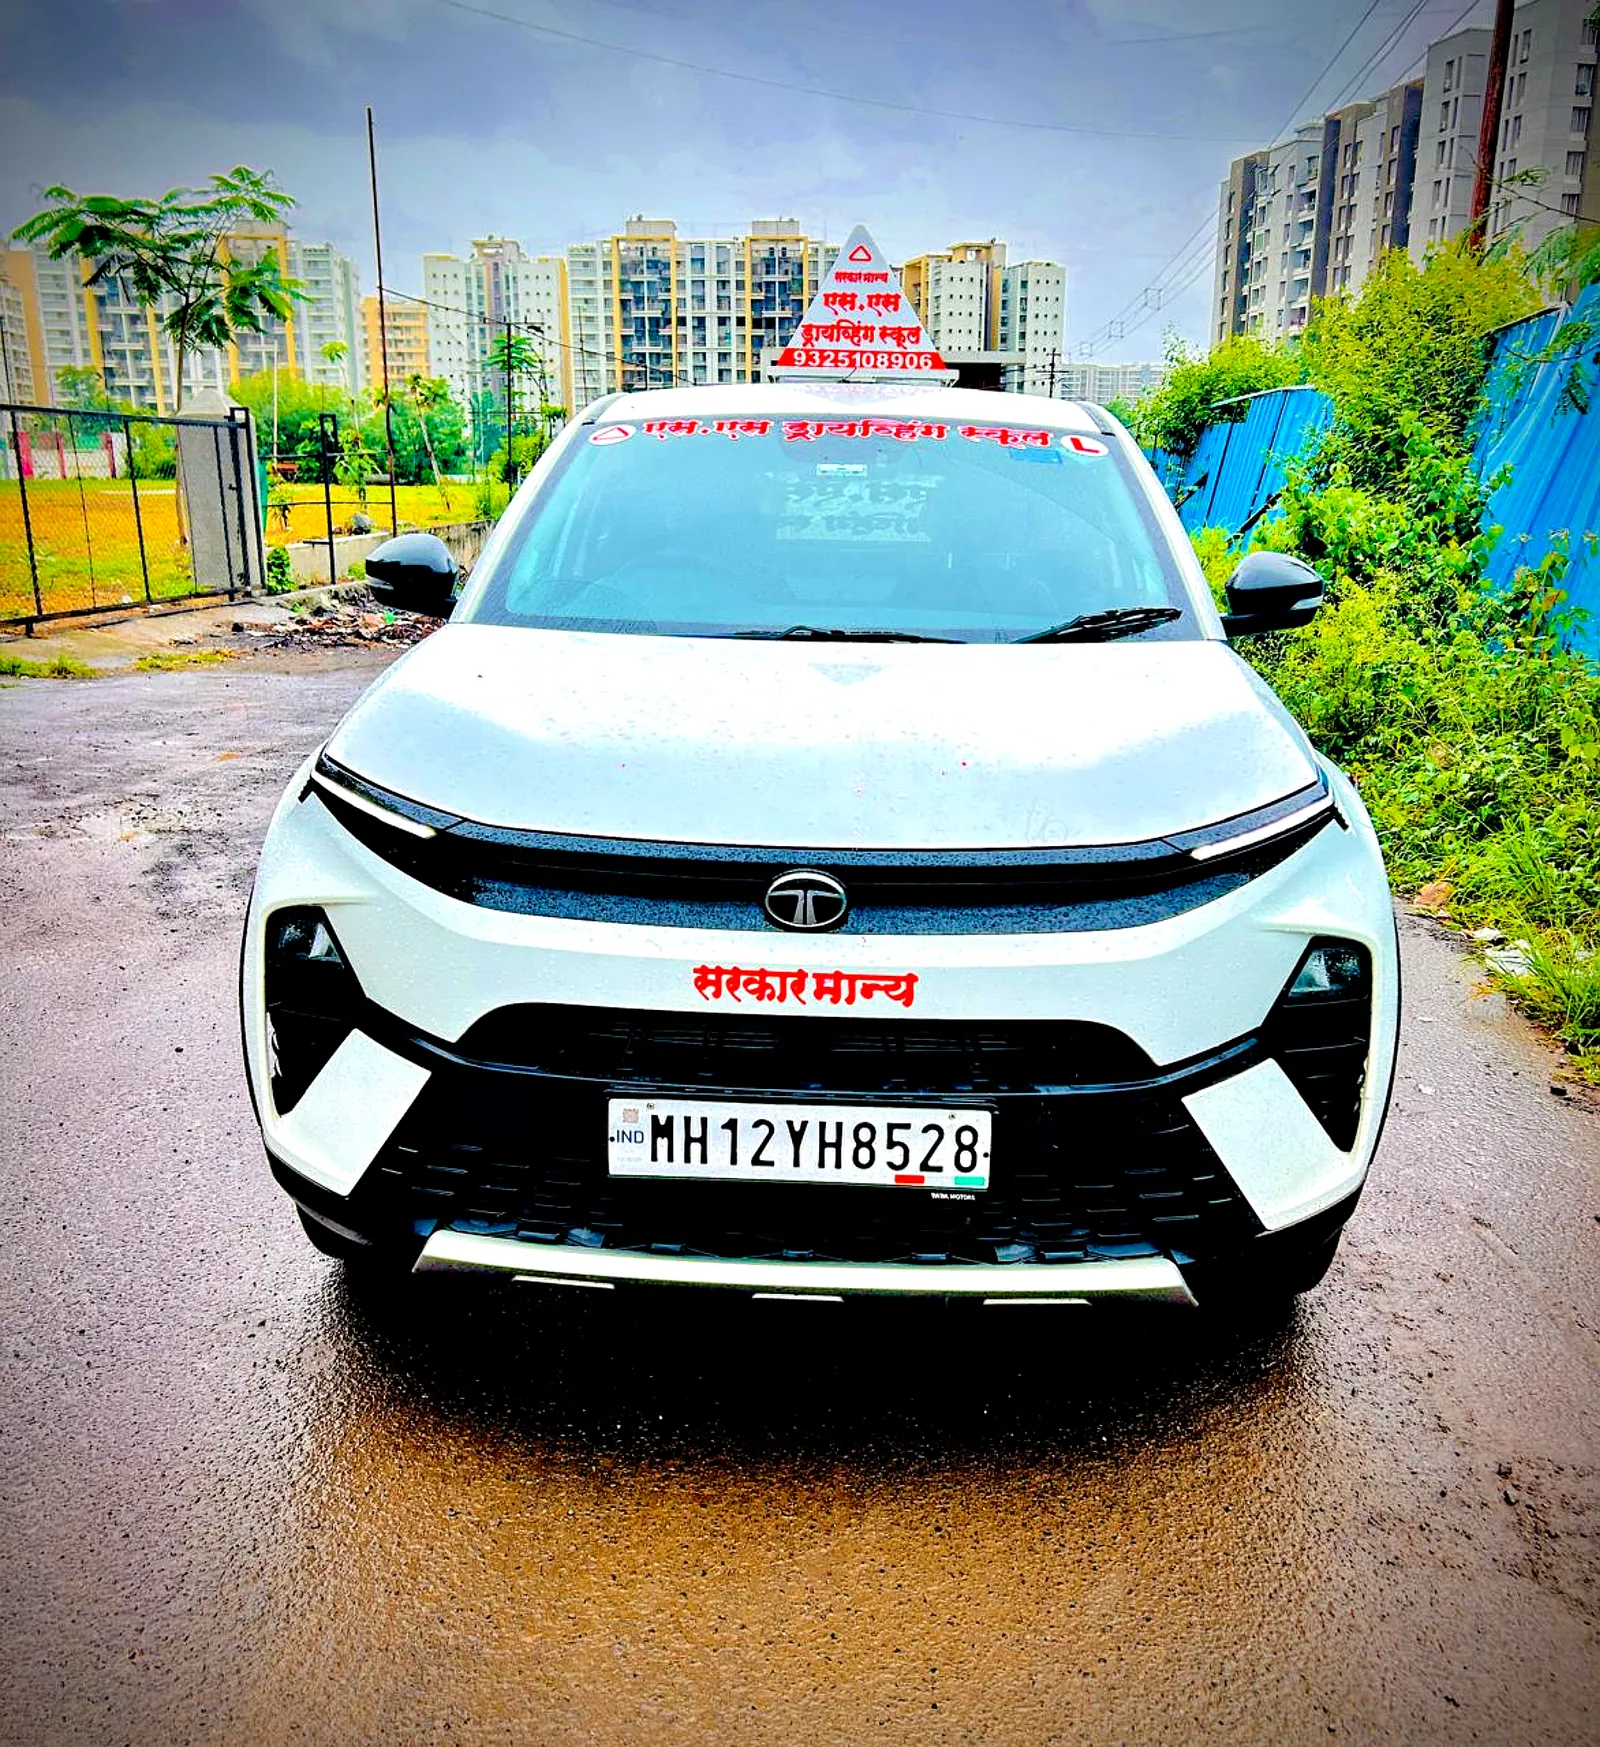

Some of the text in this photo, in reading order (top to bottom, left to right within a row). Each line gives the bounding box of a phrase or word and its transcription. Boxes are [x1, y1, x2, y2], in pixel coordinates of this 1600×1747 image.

[801, 318, 922, 350] ड्रायव्हिंग स्कूल
[793, 351, 933, 369] 9325108906
[958, 425, 1053, 449] स्कूल
[1070, 437, 1100, 454] L
[693, 965, 919, 1008] सरकार मान्य
[616, 1129, 645, 1144] IND
[650, 1114, 980, 1174] MH12YH8528
